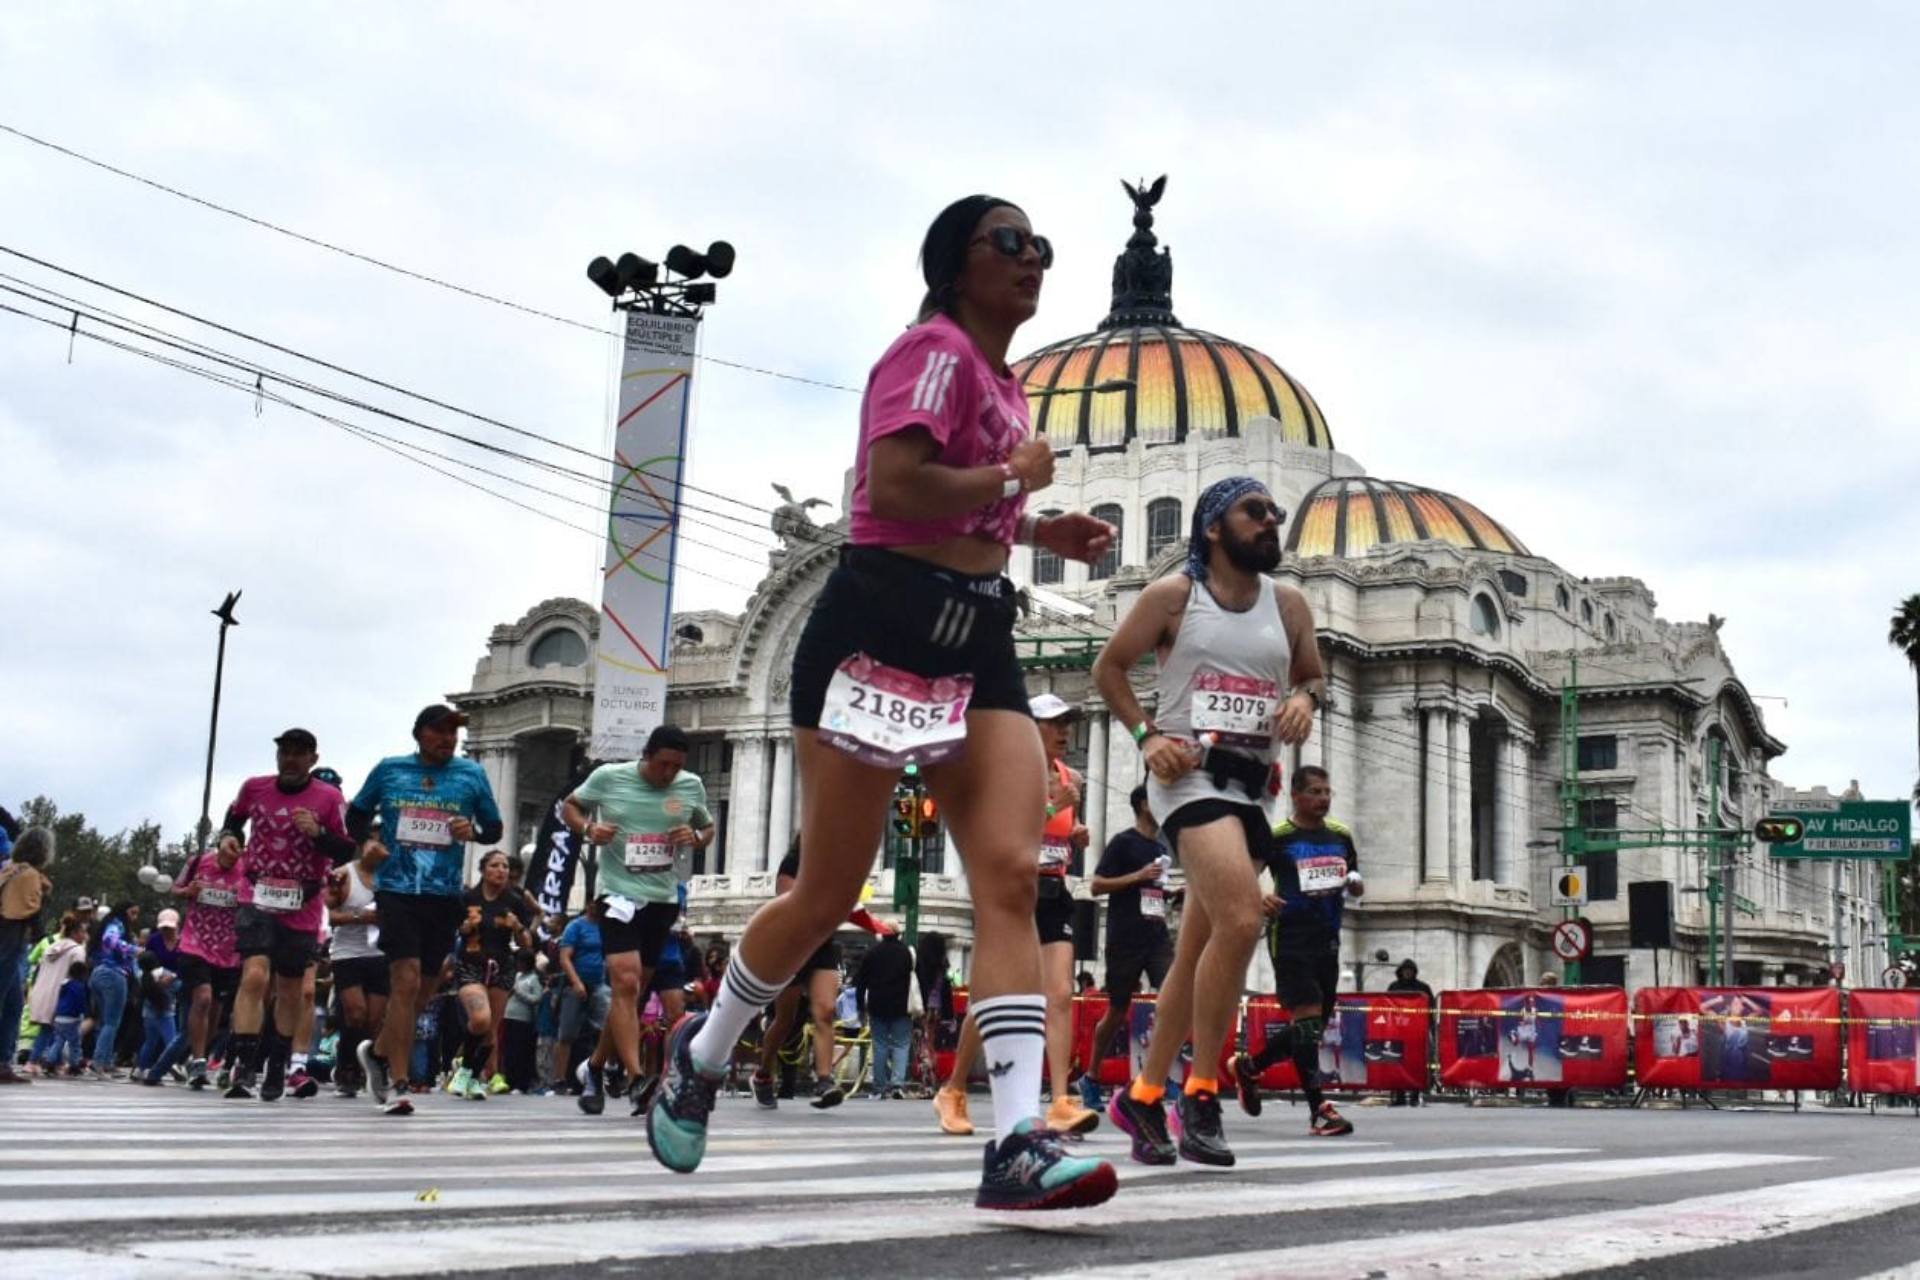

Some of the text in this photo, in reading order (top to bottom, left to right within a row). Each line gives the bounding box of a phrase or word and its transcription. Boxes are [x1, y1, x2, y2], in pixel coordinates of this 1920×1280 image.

[627, 317, 695, 334] EQUILIBRIO
[600, 698, 658, 713] OCTUBRE
[848, 685, 946, 732] 21865
[1207, 694, 1266, 717] 23079
[1806, 818, 1899, 832] AV HIDALGO
